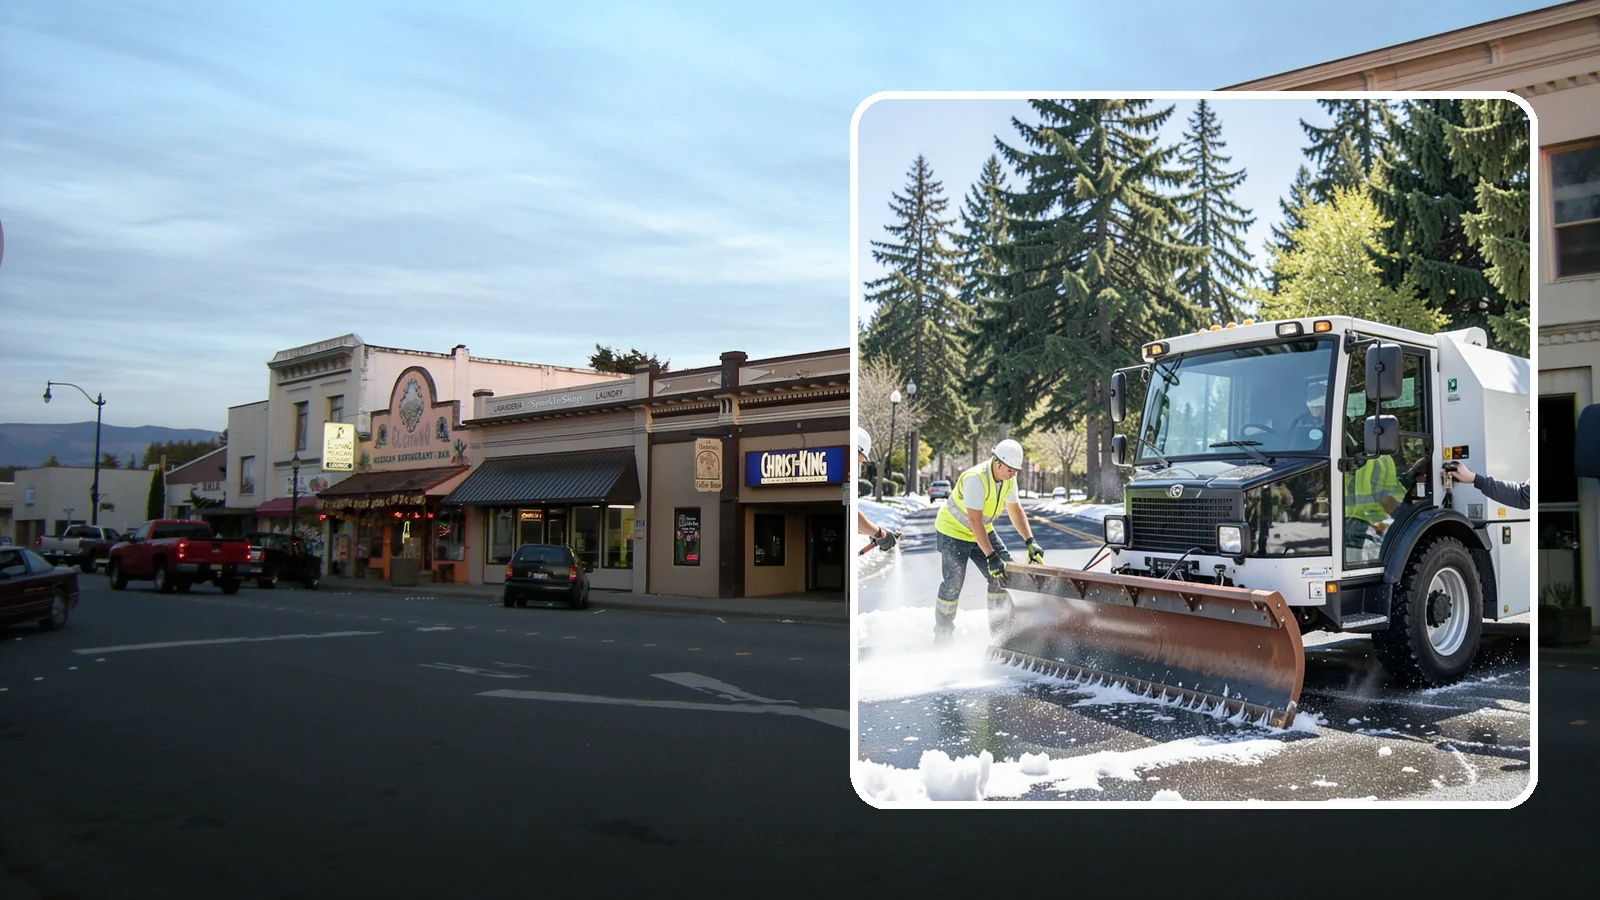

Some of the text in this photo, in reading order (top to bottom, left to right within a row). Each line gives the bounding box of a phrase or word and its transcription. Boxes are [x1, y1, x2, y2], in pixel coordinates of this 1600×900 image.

[595, 389, 623, 400] LAUNDRY
[493, 402, 522, 412] LAVANDERIA
[530, 395, 582, 409] Sparkle Shop
[373, 450, 450, 464] MEXICAN RESTAURANT BAR
[760, 450, 827, 478] CHRIST KING
